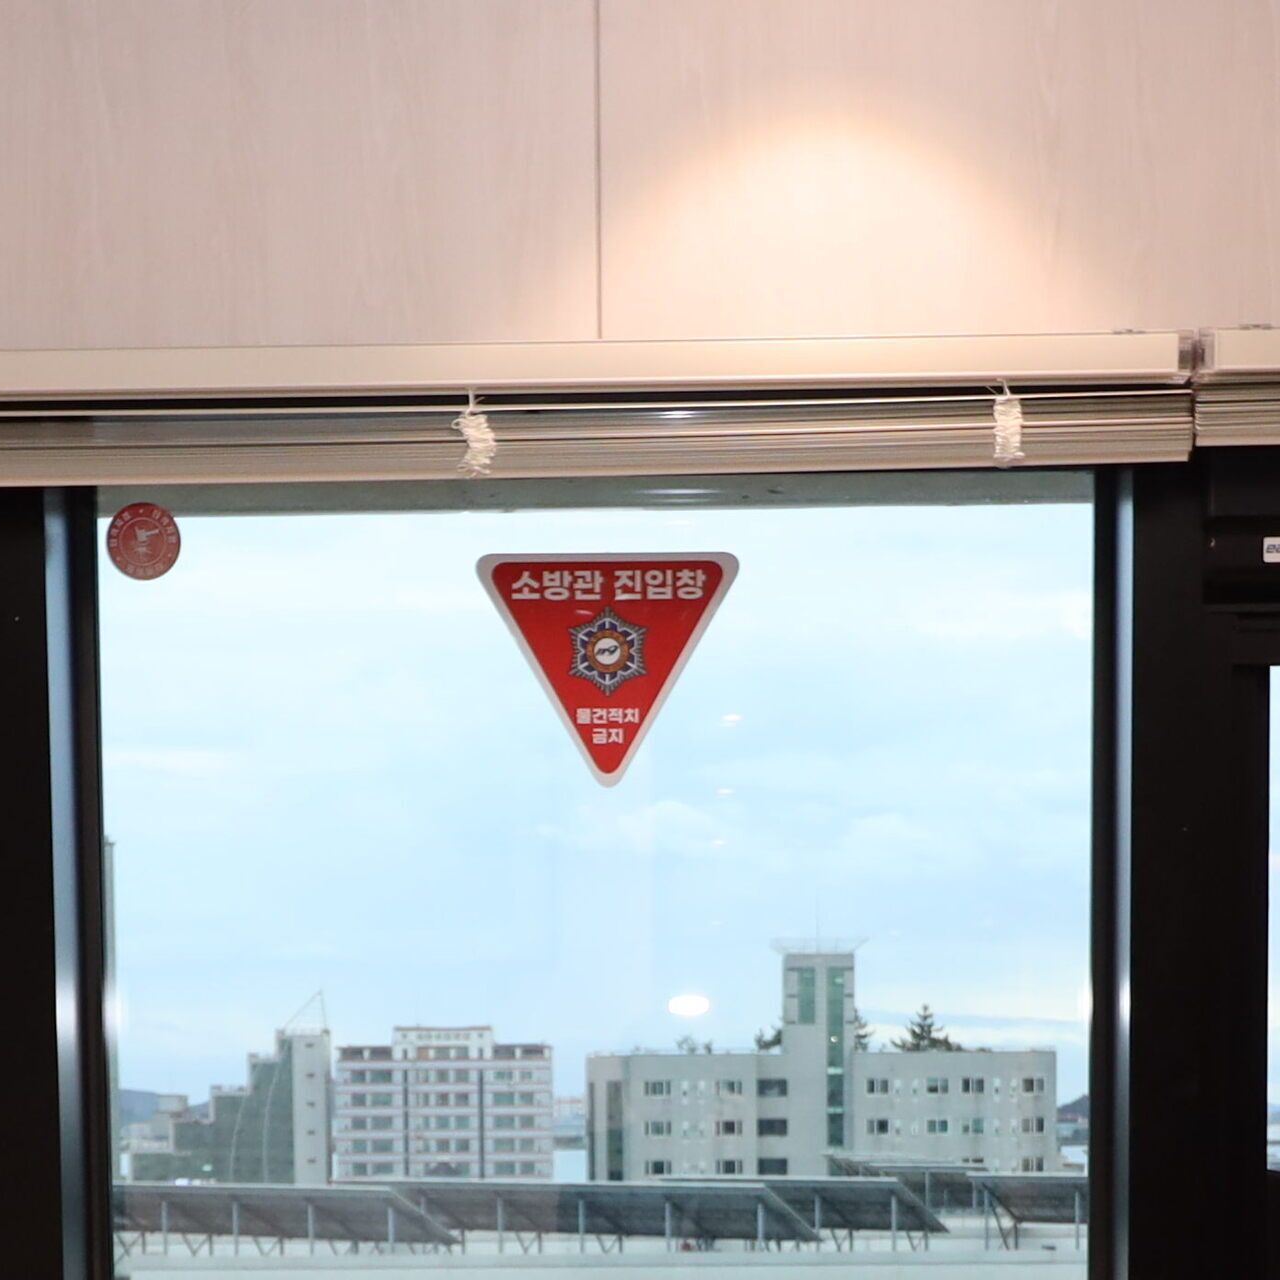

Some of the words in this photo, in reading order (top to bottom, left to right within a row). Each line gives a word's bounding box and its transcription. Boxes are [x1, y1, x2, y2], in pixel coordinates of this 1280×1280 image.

[512, 570, 603, 600] 소방관
[614, 570, 706, 600] 진입창
[577, 709, 639, 724] 물건적치
[592, 728, 624, 743] 금지
